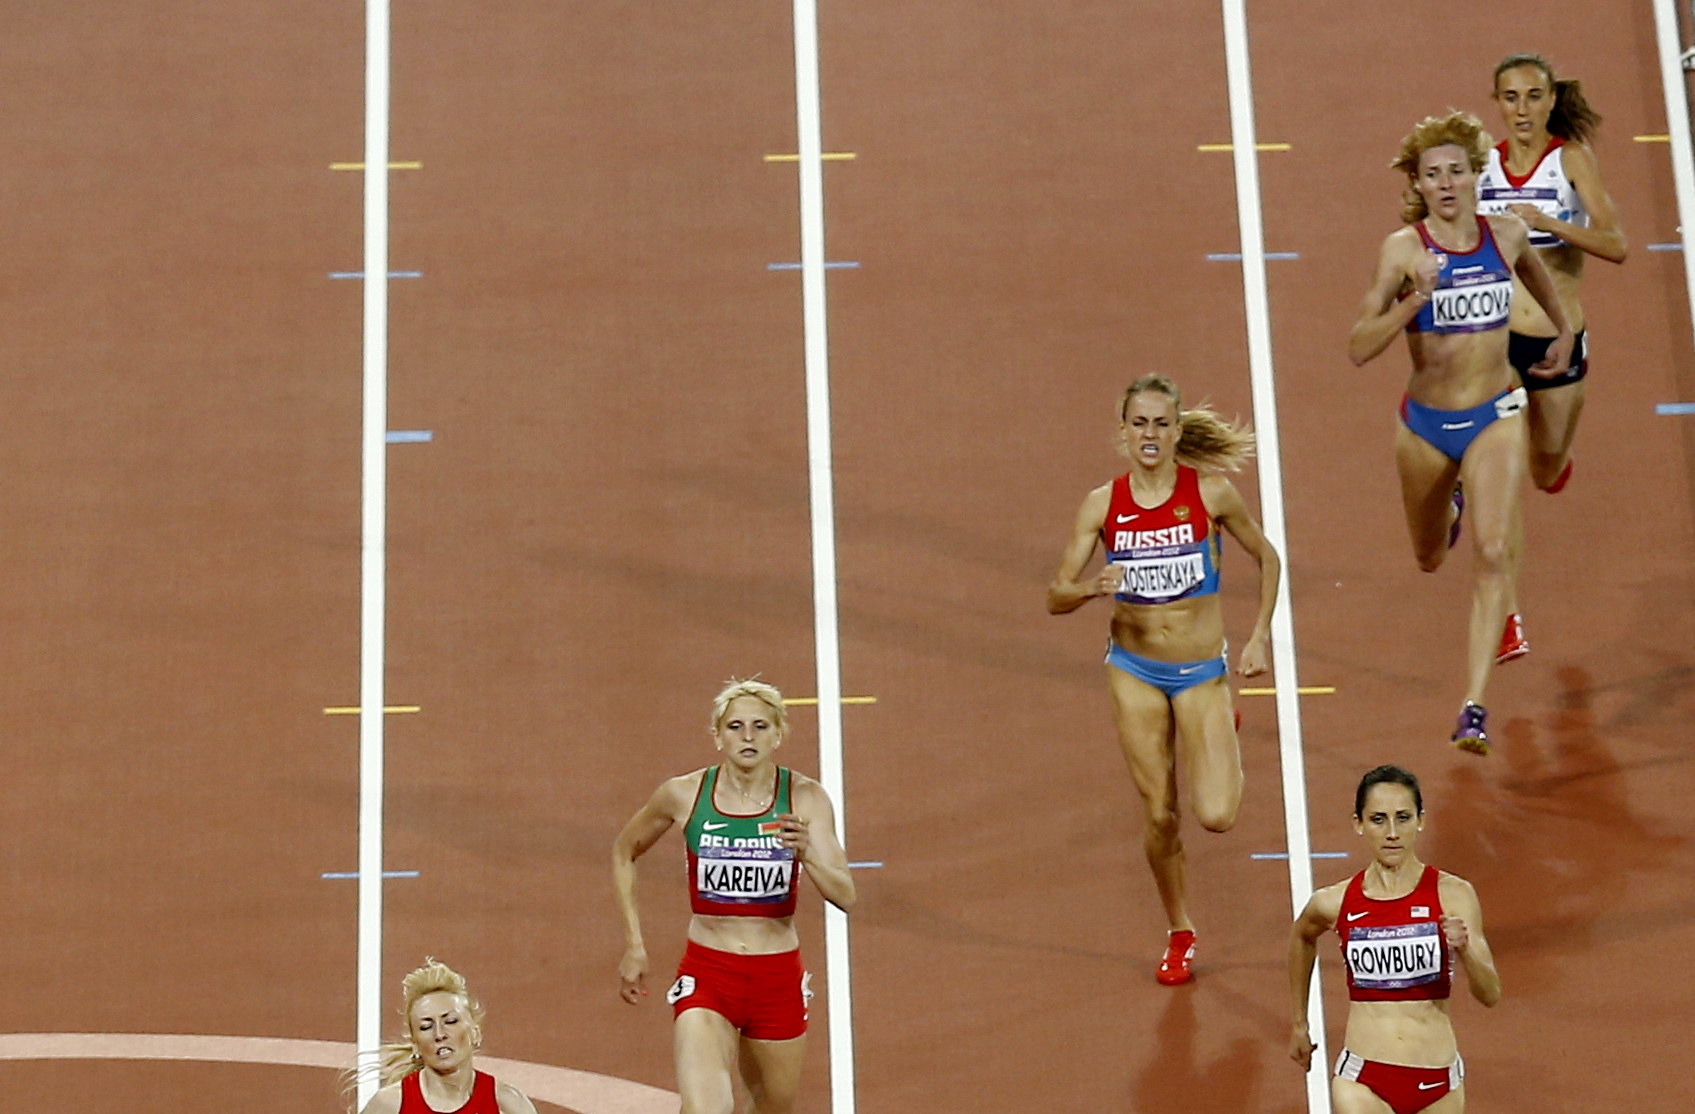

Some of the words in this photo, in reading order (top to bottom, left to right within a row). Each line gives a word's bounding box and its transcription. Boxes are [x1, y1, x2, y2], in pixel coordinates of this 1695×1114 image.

[1114, 523, 1194, 552] RUSSIA
[704, 864, 785, 893] KAREIVA
[1351, 942, 1436, 974] ROWBURY
